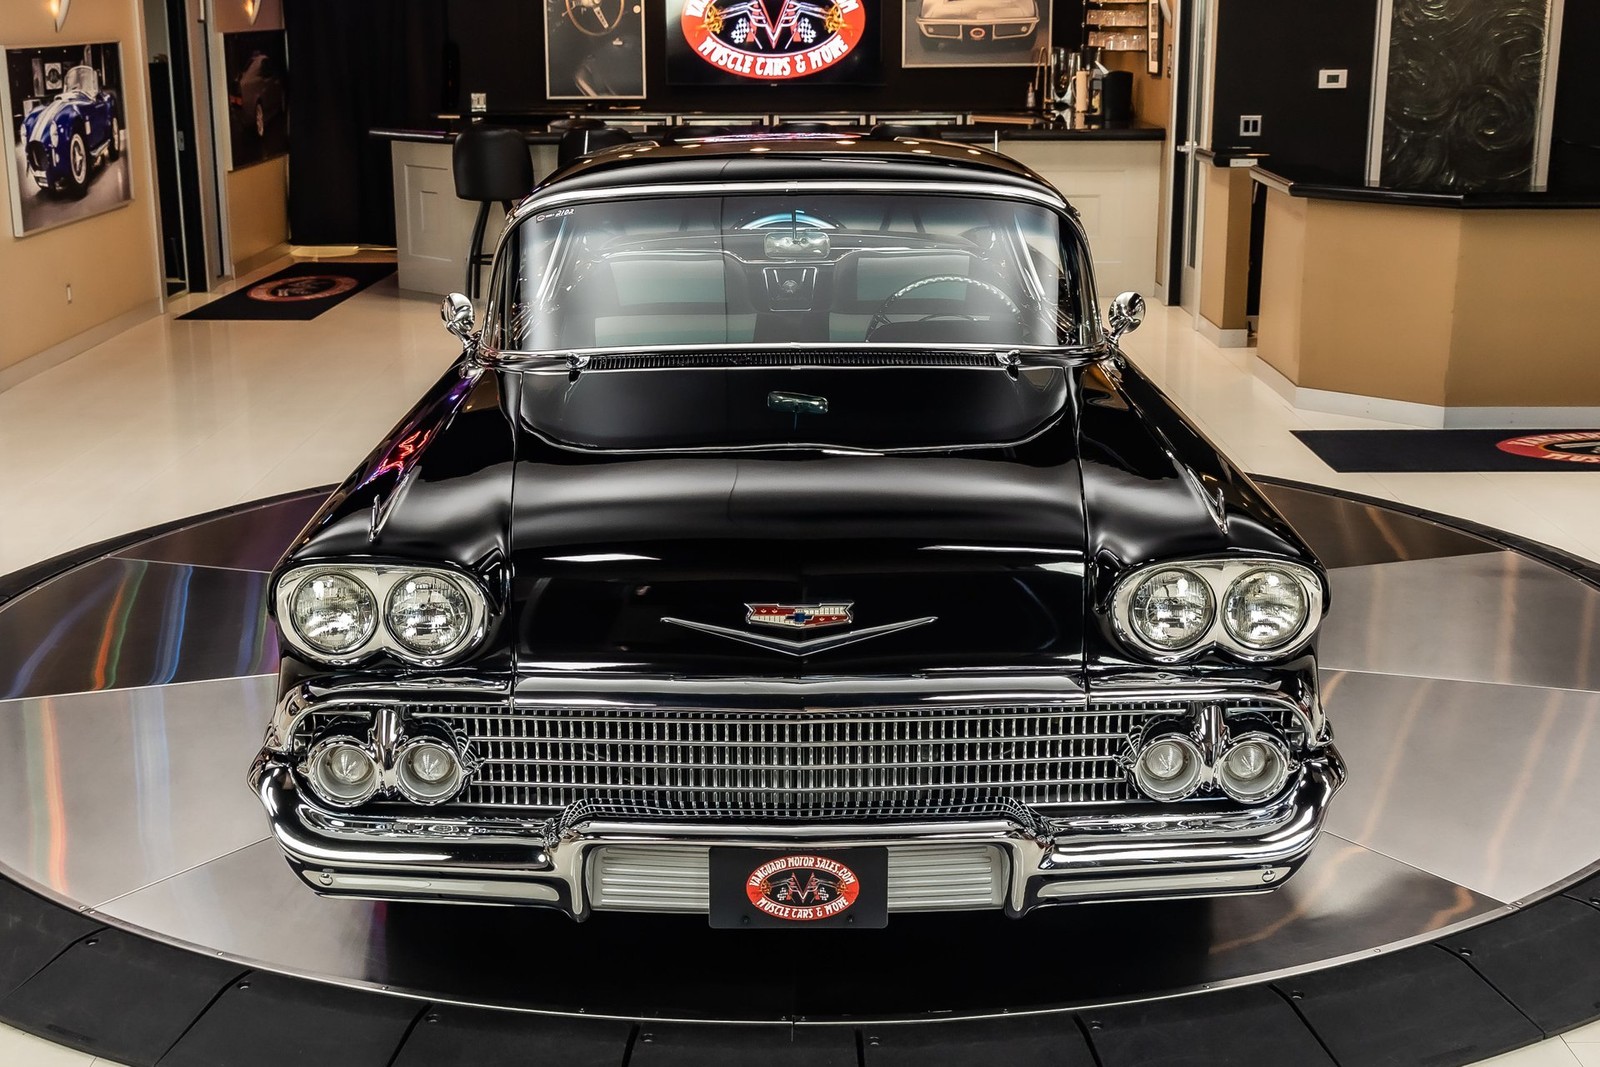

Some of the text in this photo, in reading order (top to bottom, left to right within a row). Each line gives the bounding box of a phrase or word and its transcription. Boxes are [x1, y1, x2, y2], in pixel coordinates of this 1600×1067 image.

[698, 35, 849, 76] MUSCLE CARS & MORE
[749, 857, 856, 887] VANGUARD MOTOR SALES.COM
[757, 896, 849, 919] MUSCLE CARS & MORE
